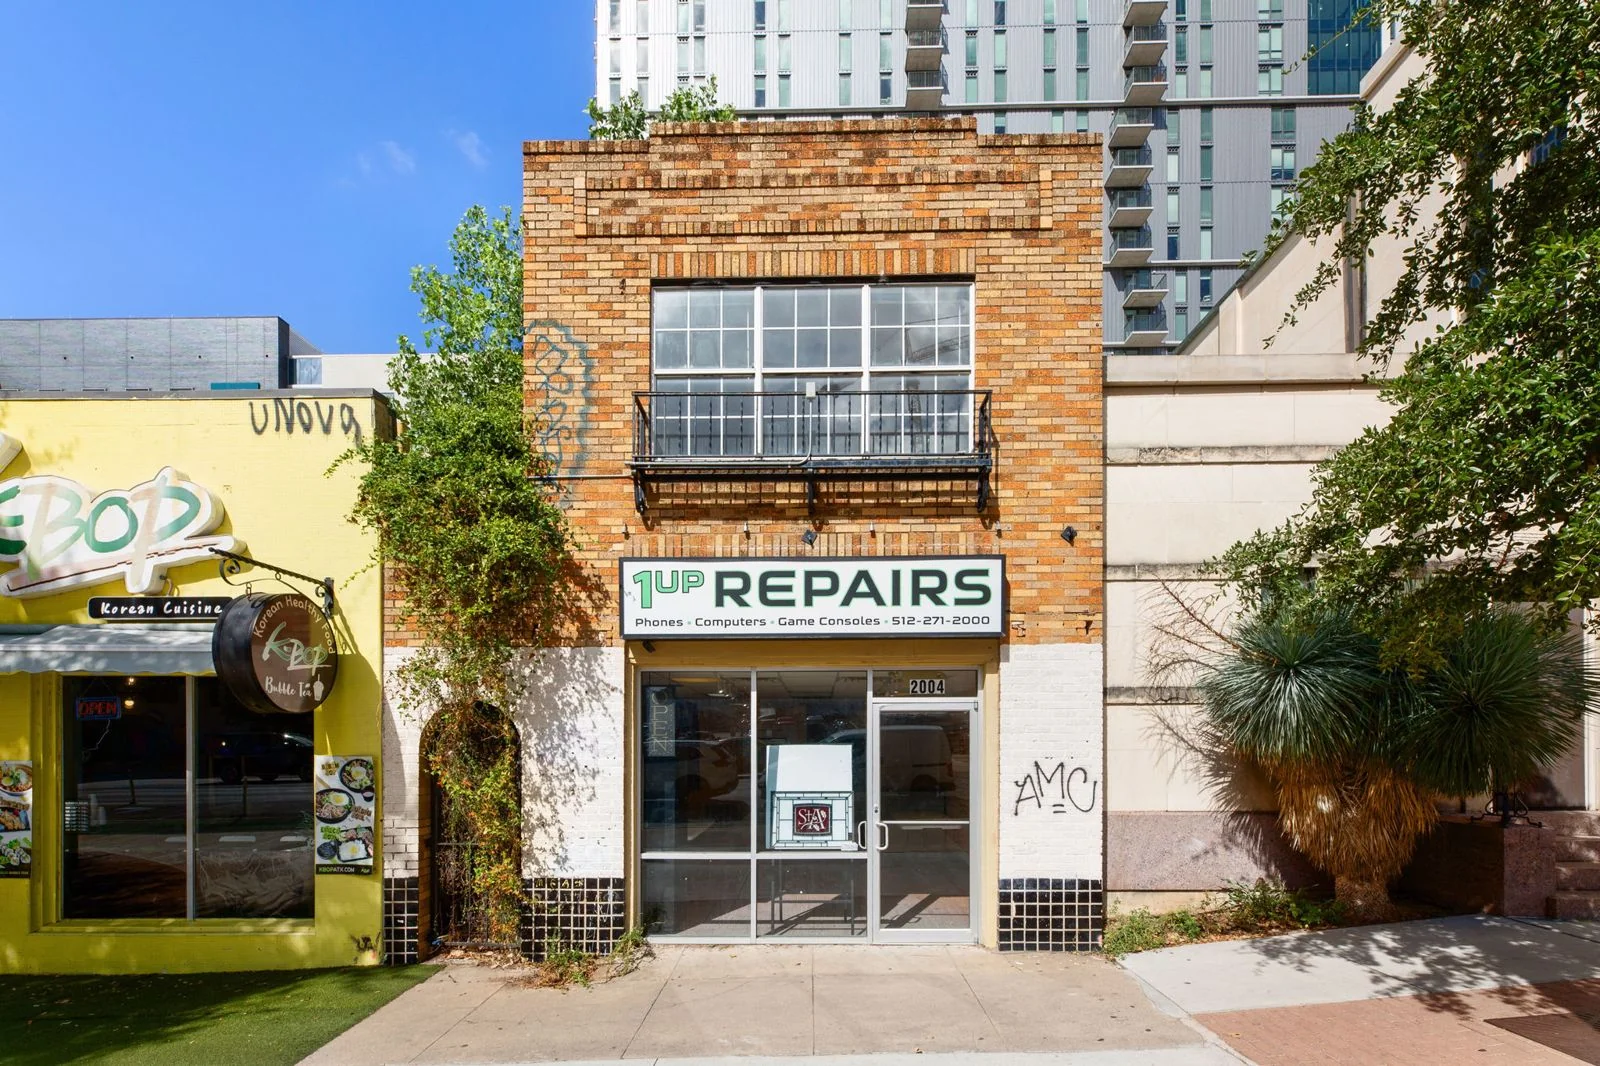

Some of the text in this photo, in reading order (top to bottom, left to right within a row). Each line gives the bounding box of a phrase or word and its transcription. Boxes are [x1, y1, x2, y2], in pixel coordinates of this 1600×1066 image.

[633, 568, 992, 608] 1UP REPAIRS
[100, 600, 223, 615] Korean Cuisine
[253, 595, 336, 654] Korean Healthy Food
[635, 616, 990, 629] Phones Computers Game Consoles 512-271-2000
[265, 675, 312, 697] Bubble Tea
[910, 679, 945, 694] 2004
[78, 701, 117, 715] OPEN
